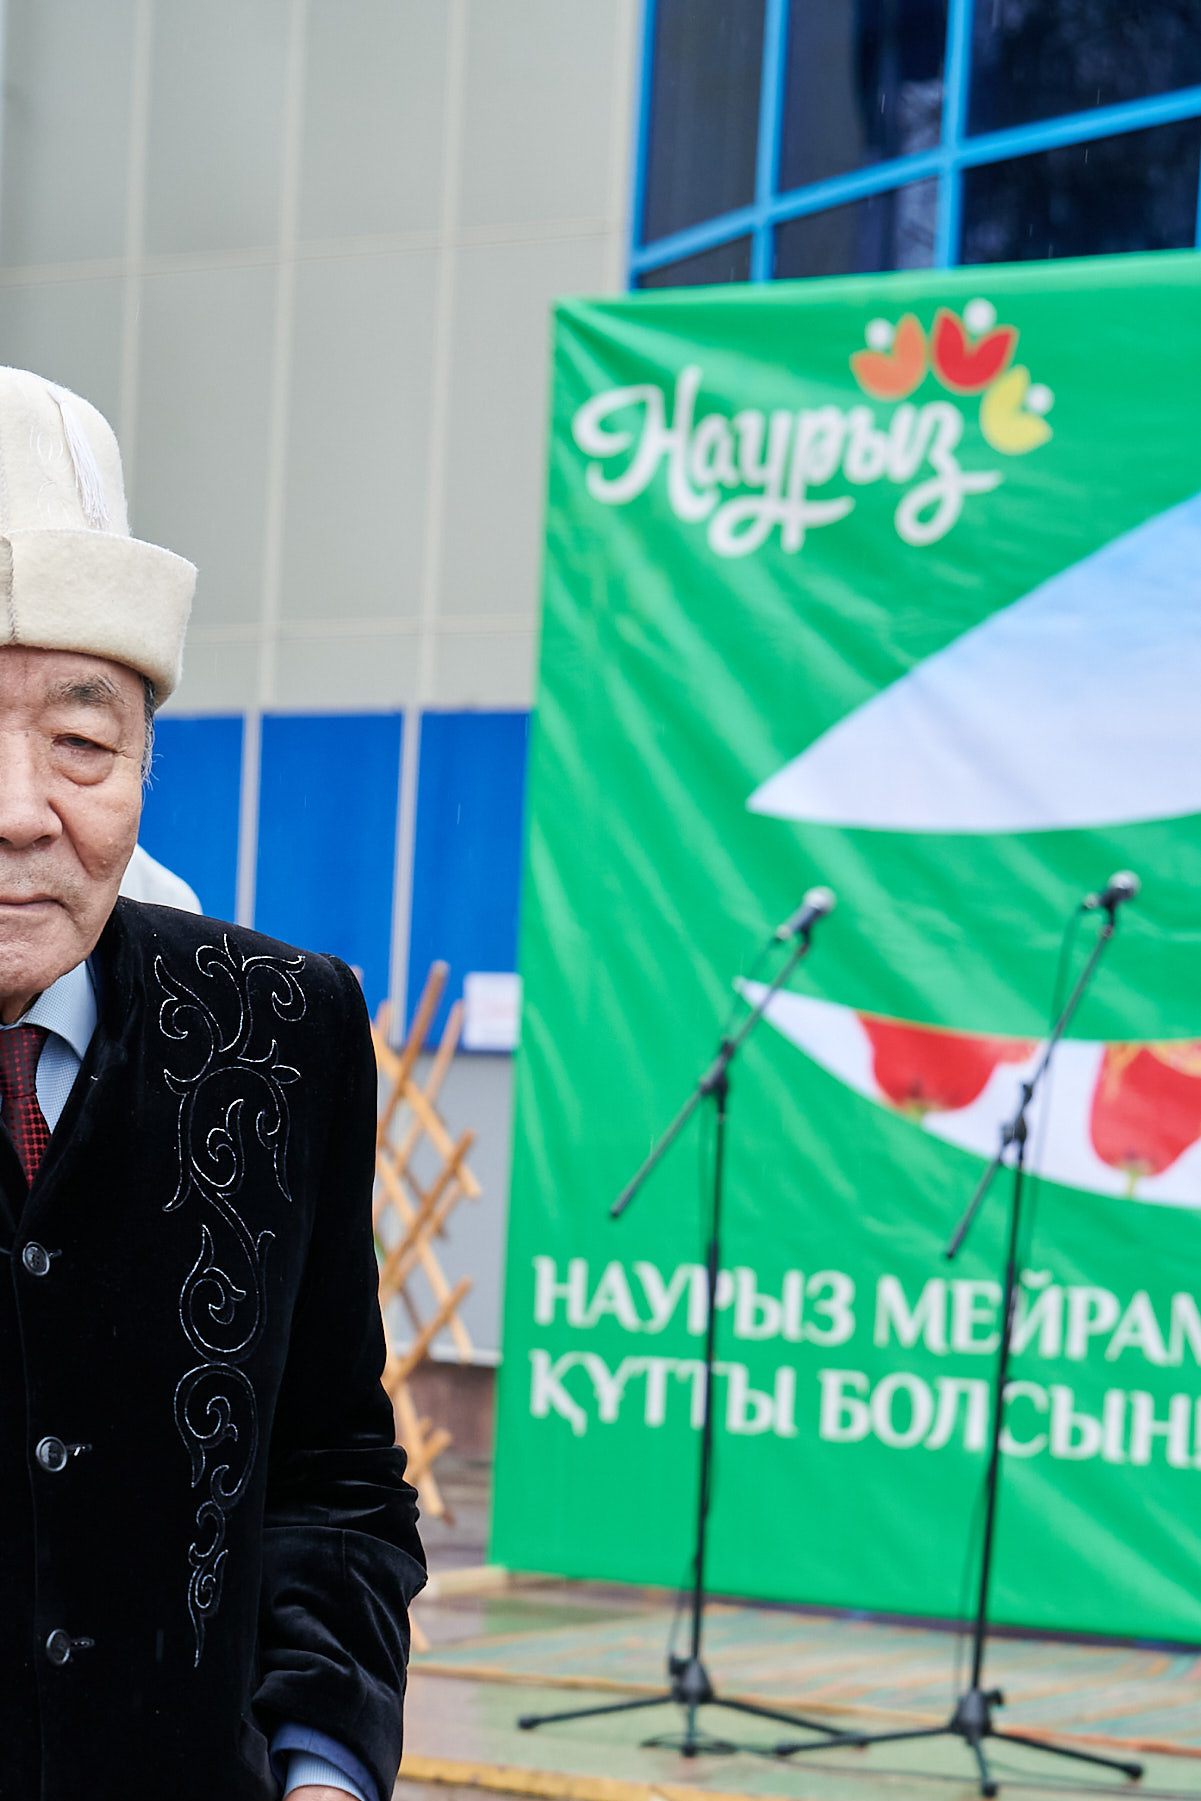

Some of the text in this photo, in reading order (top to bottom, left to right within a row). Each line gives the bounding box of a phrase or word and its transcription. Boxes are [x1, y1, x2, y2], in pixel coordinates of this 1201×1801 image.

[572, 365, 1004, 557] Наурыз
[532, 1255, 856, 1347] НАУРЫЗ
[817, 1368, 1201, 1471] БОЛСЫН
